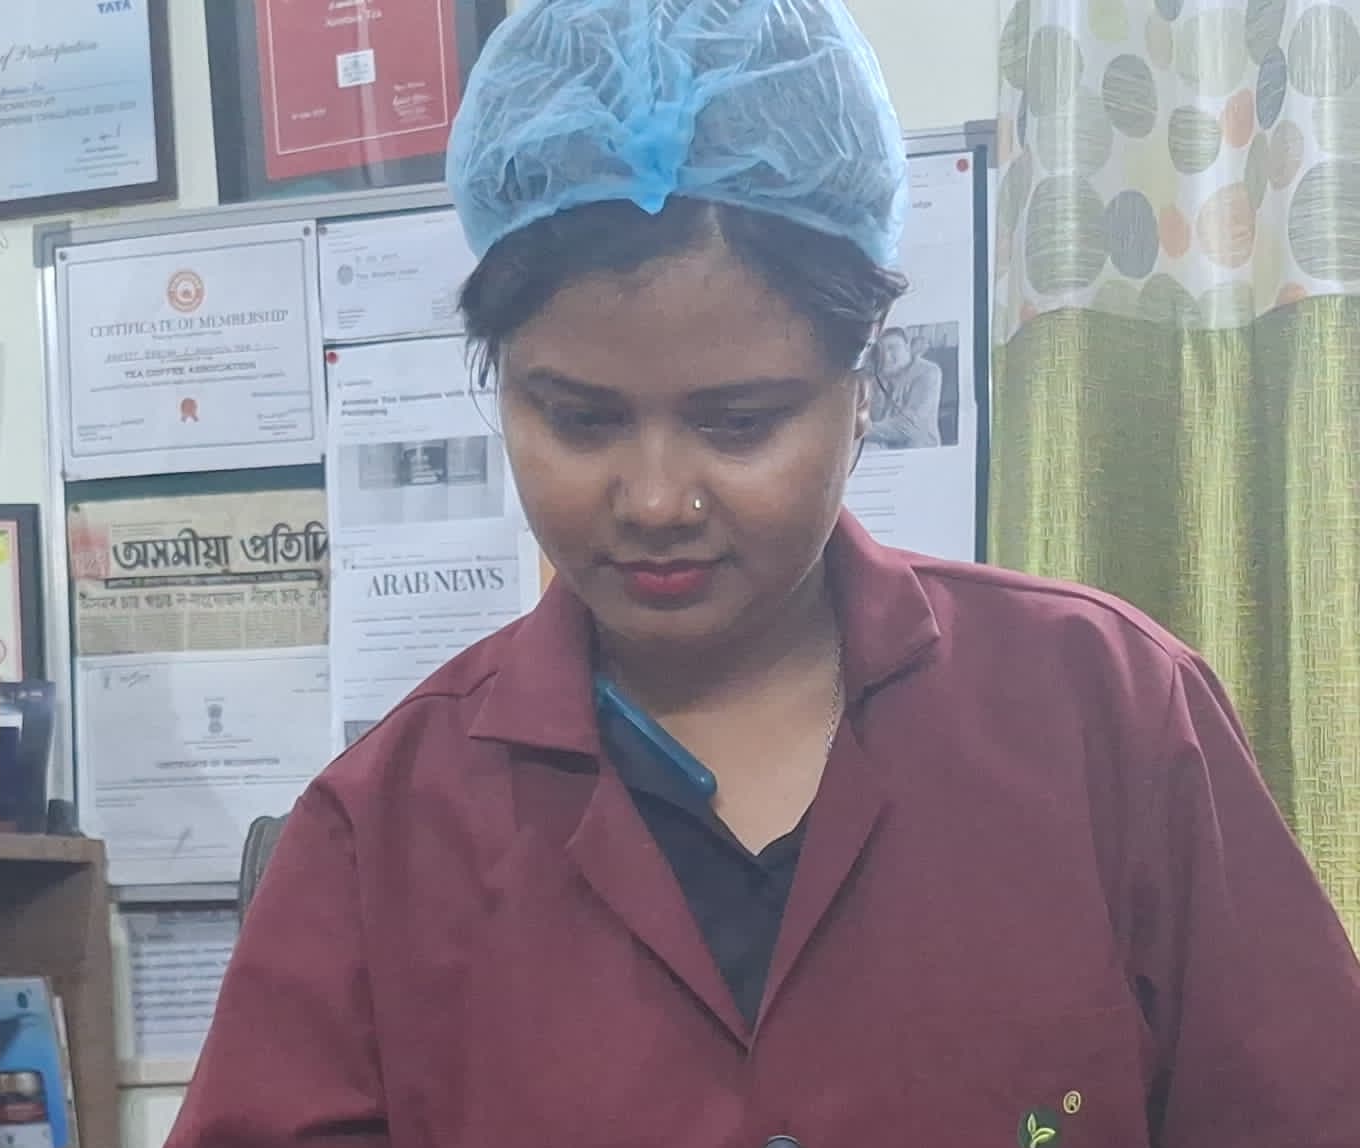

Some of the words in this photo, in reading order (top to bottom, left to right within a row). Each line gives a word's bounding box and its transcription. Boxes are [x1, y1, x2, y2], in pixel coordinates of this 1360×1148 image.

[97, 0, 131, 14] TATA
[90, 319, 173, 338] CERTIFICATE
[178, 318, 194, 330] OF
[199, 310, 289, 329] MEMBERSHIP
[368, 571, 430, 598] ARAB
[434, 567, 505, 593] NEWS
